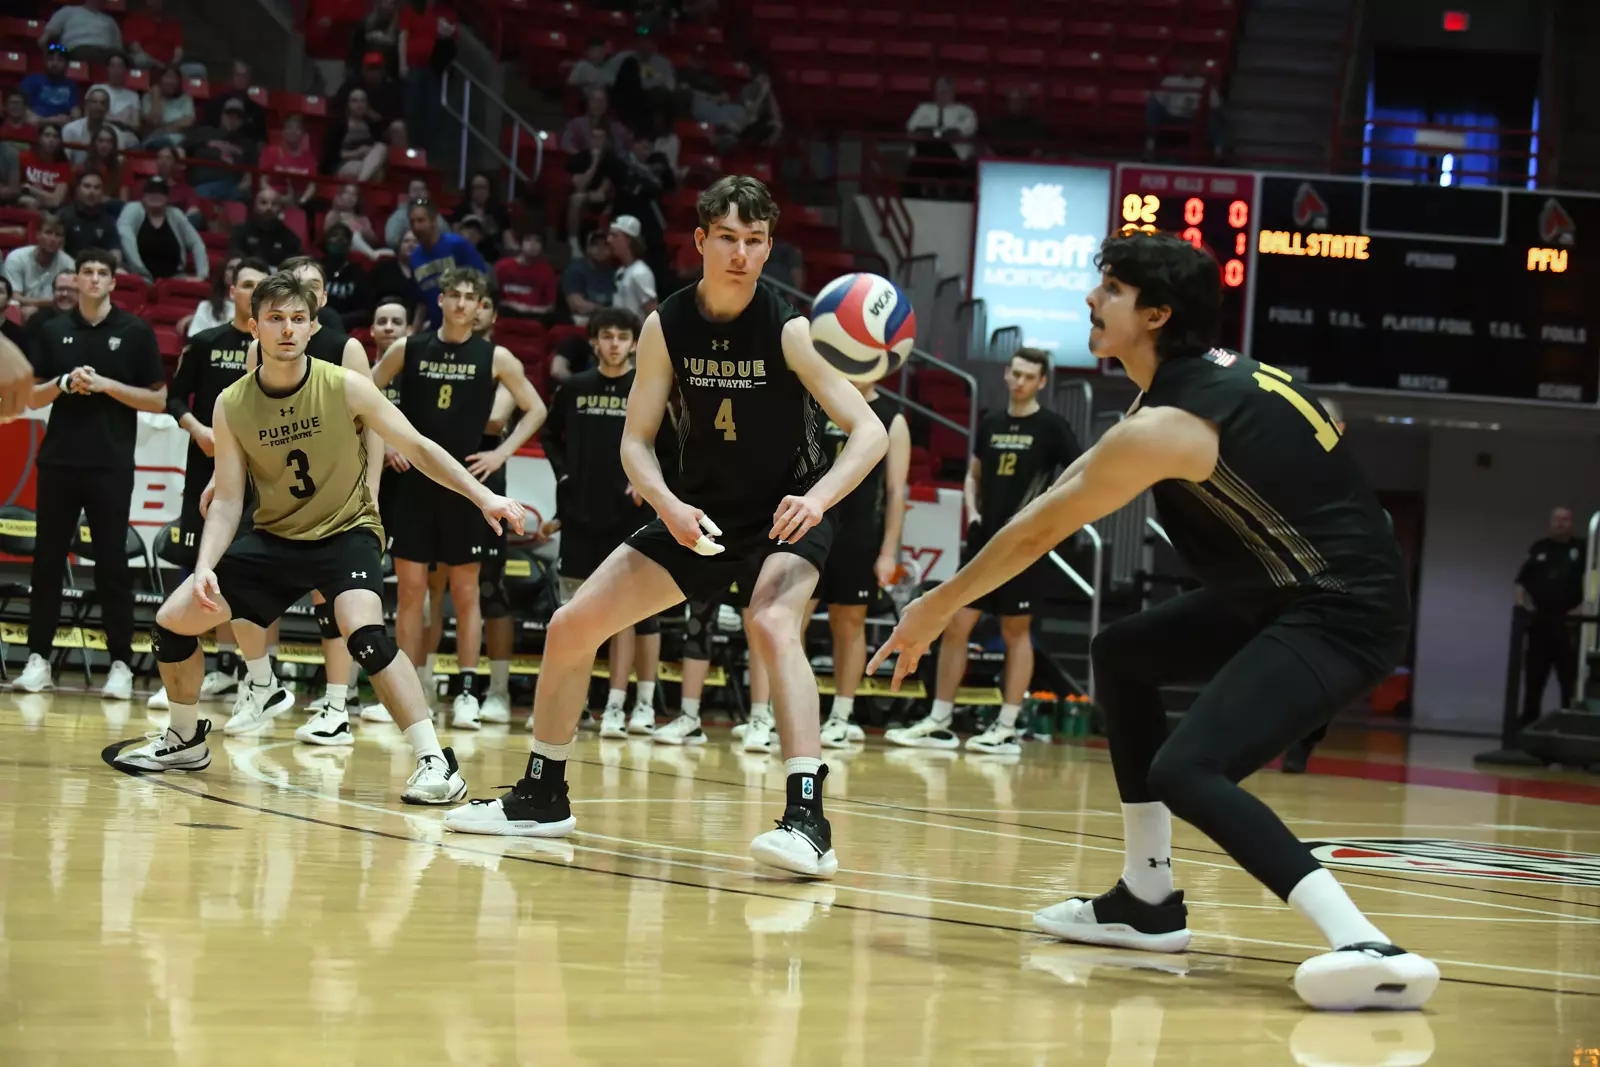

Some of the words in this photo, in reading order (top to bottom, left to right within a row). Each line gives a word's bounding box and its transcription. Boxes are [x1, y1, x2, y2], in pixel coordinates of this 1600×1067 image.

[1122, 193, 1160, 223] 02
[1184, 197, 1204, 226] 0
[1228, 200, 1249, 228] 0
[986, 229, 1095, 268] Ruoff
[983, 267, 1093, 290] MORTGAGE
[211, 349, 246, 362] PUR
[420, 361, 476, 375] PURDUE
[689, 376, 716, 388] FORT
[717, 378, 752, 389] WAYNE
[437, 384, 453, 410] 8
[259, 416, 320, 441] PURDUE
[714, 398, 737, 441] 4
[270, 437, 290, 447] FORT
[286, 448, 316, 499] 3
[997, 452, 1017, 476] 12
[62, 588, 84, 598] TATE
